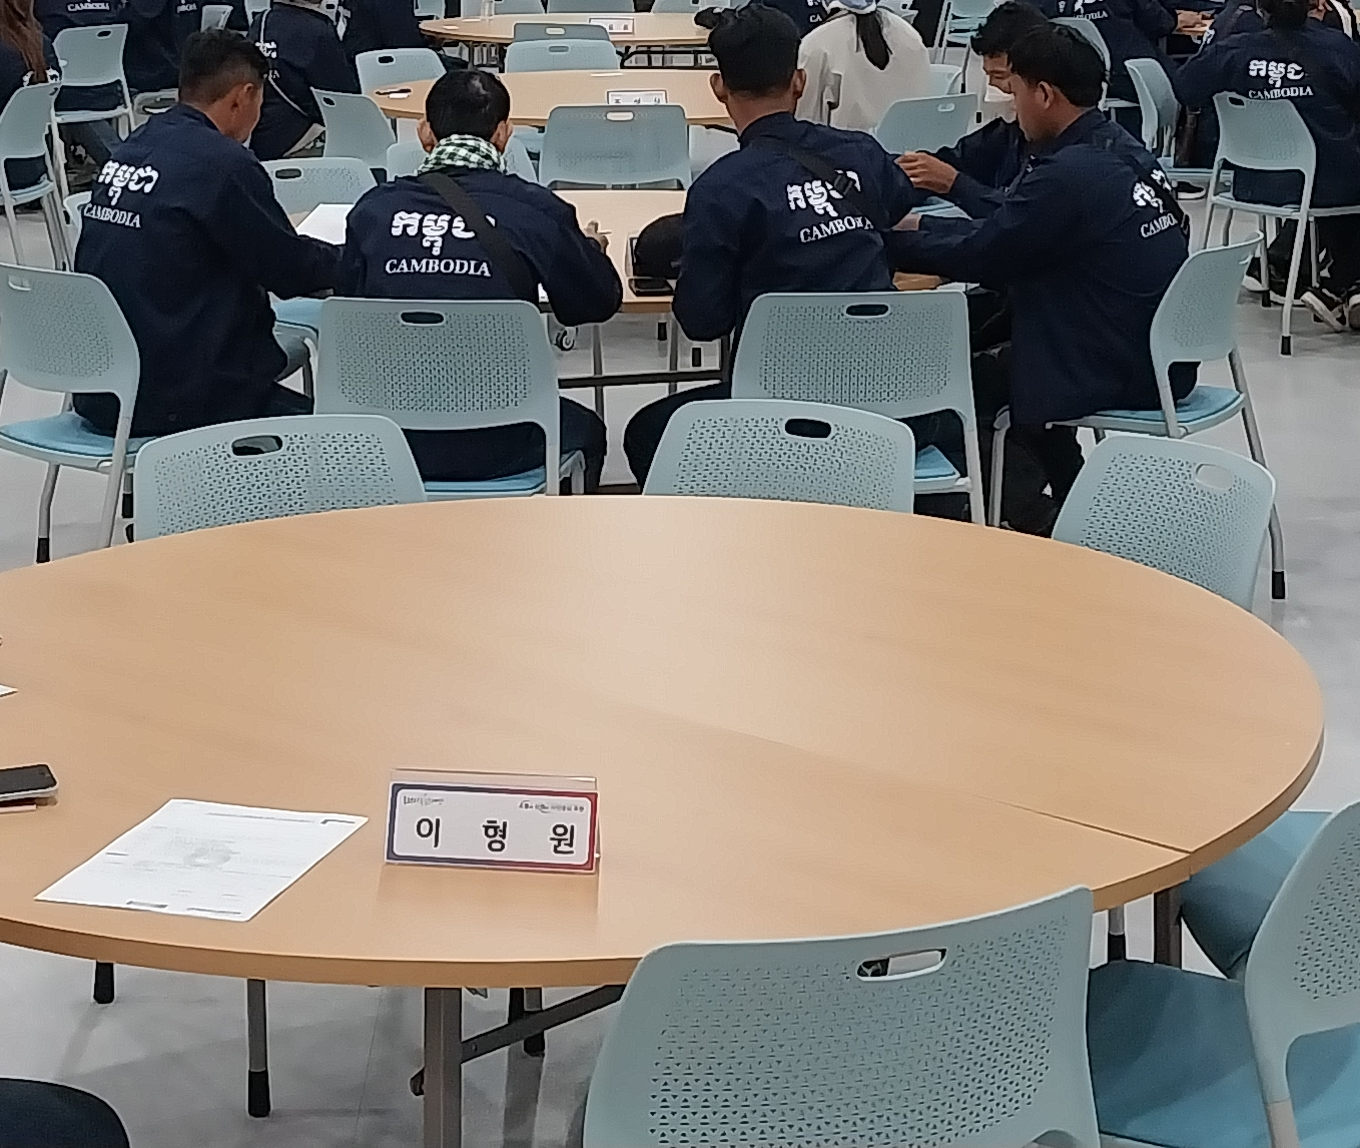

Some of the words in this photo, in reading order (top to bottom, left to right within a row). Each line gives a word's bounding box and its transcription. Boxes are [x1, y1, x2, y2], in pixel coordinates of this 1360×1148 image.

[1248, 85, 1313, 100] CAMBODIA
[83, 203, 142, 228] CAMBODIA
[1140, 213, 1178, 238] CAMBO
[385, 258, 492, 277] CAMBODIA
